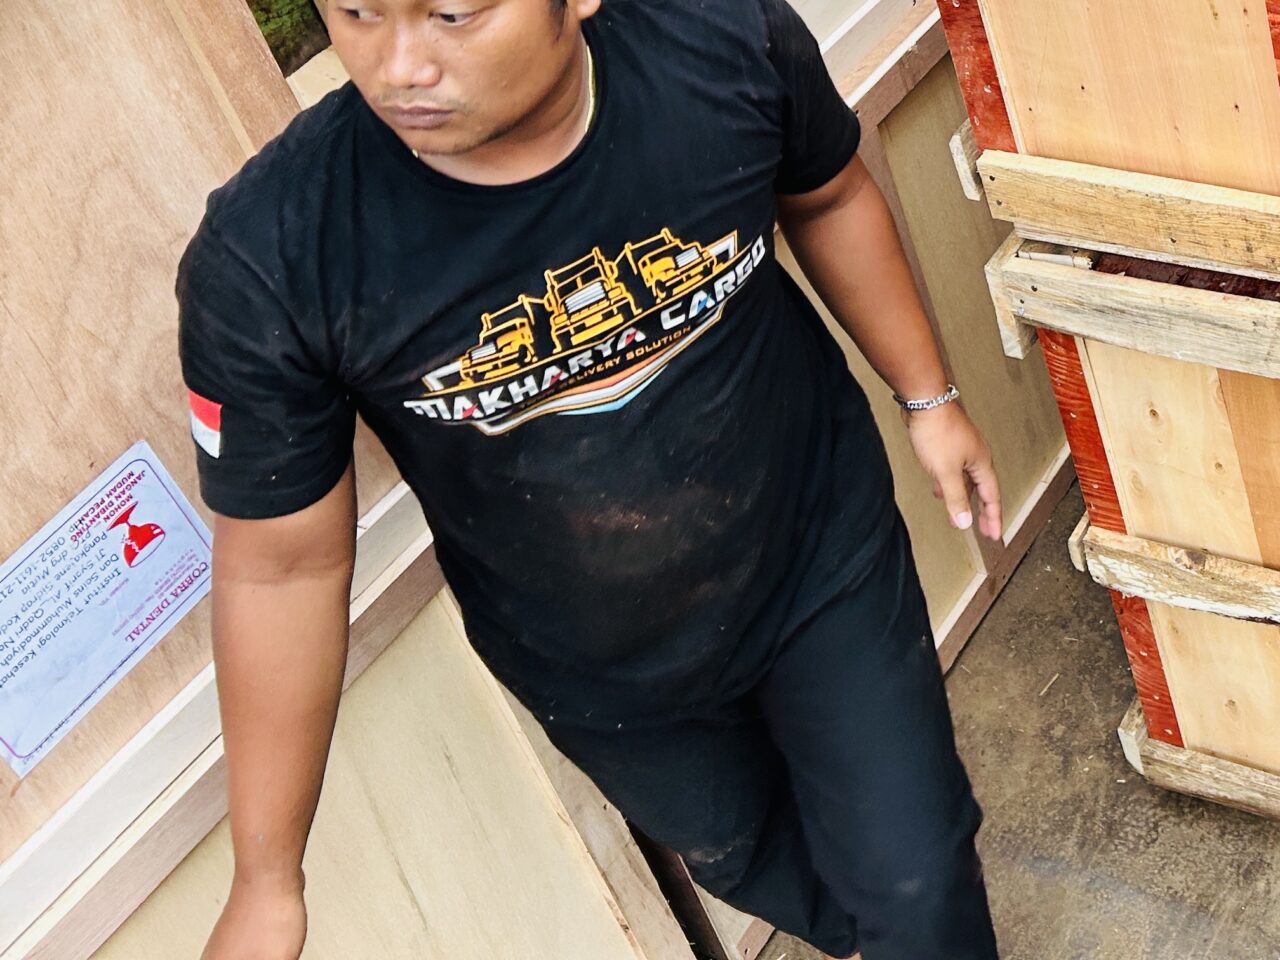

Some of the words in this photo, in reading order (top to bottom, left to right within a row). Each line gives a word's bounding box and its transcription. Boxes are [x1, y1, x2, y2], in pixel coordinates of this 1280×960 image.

[403, 326, 647, 421] MAKHARYA
[658, 234, 767, 332] CARGO
[624, 325, 692, 361] SOLUTION
[106, 471, 134, 498] MUDAH
[115, 470, 145, 501] JANGAN
[71, 501, 114, 542] DIBANTING
[103, 494, 133, 522] MOHON
[51, 550, 67, 567] drg
[62, 559, 95, 593] Syarif
[100, 554, 119, 571] Dan
[73, 572, 98, 597] Sains
[85, 568, 121, 604] Institut
[170, 562, 209, 598] COBRA
[0, 614, 20, 635] Kod
[0, 598, 72, 666] Muhammadiyah
[38, 608, 83, 648] Teknologi
[125, 598, 171, 641] DENTAL
